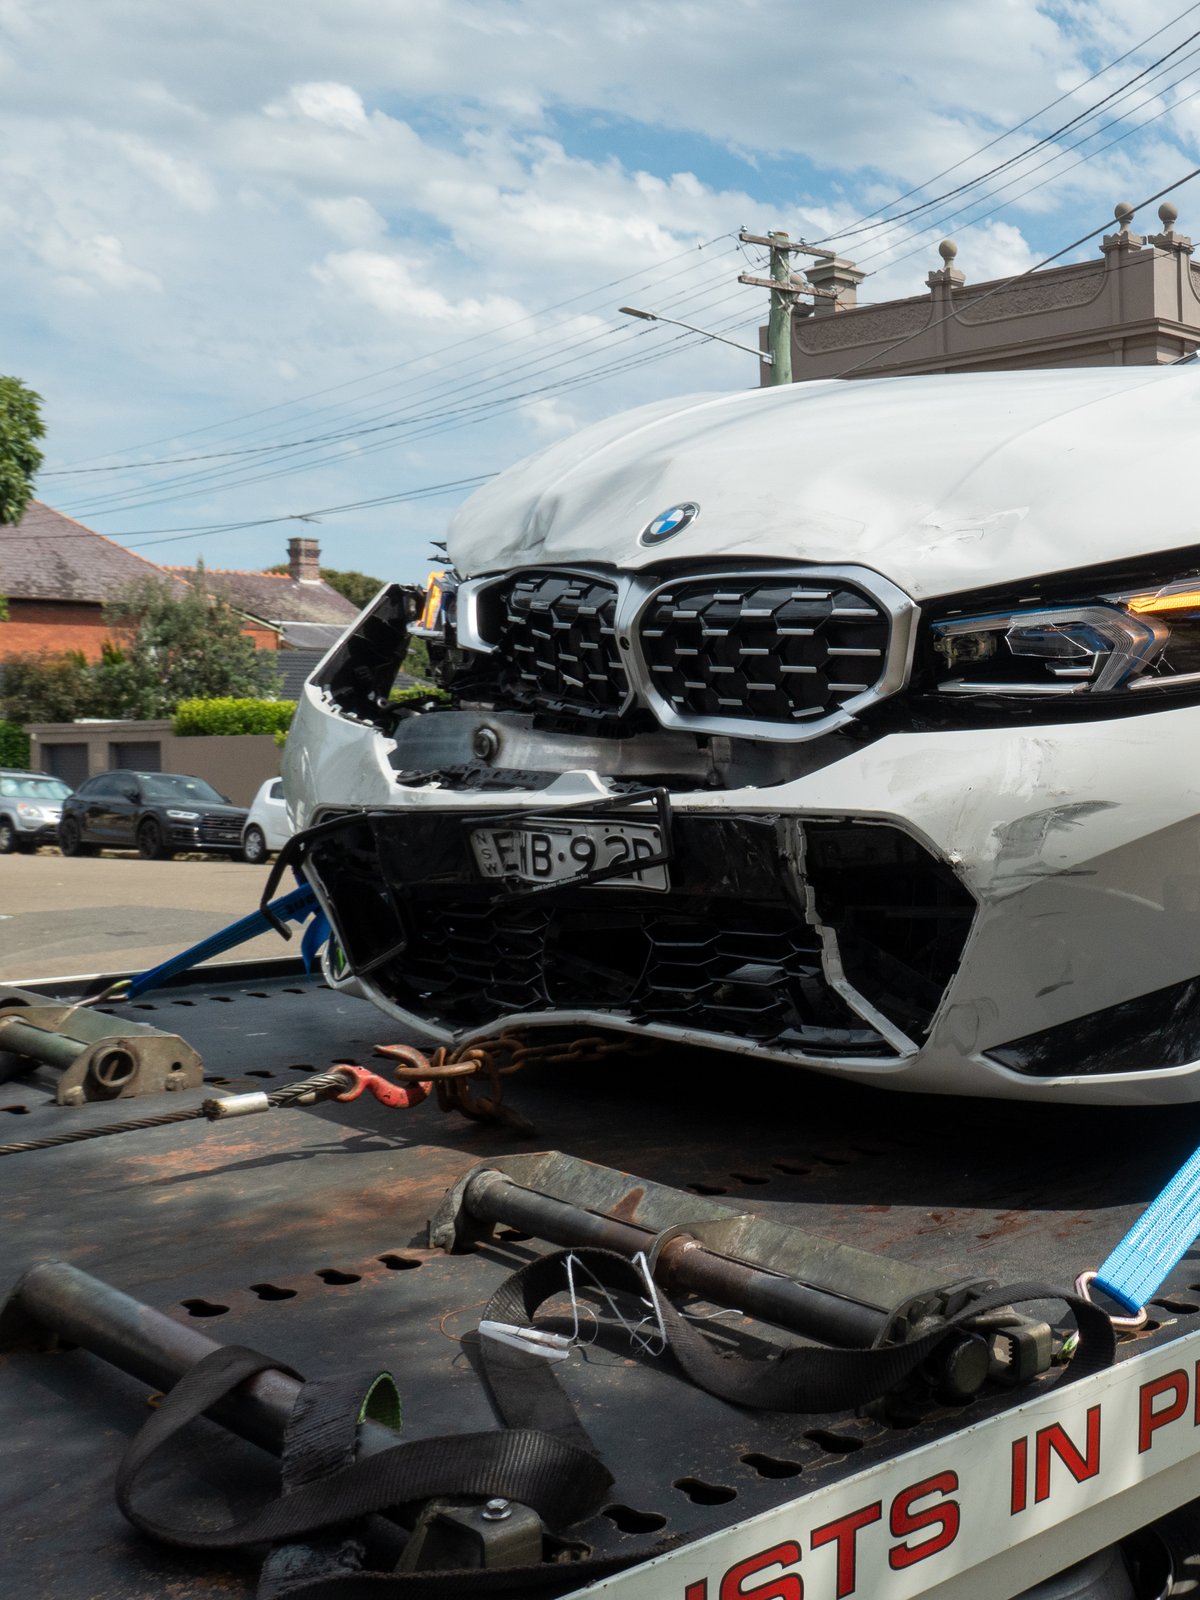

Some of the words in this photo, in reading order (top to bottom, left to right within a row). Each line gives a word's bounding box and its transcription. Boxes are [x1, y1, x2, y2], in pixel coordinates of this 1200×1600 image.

[476, 832, 498, 874] NSW
[685, 1469, 961, 1600] STS
[1010, 1404, 1102, 1516] IN
